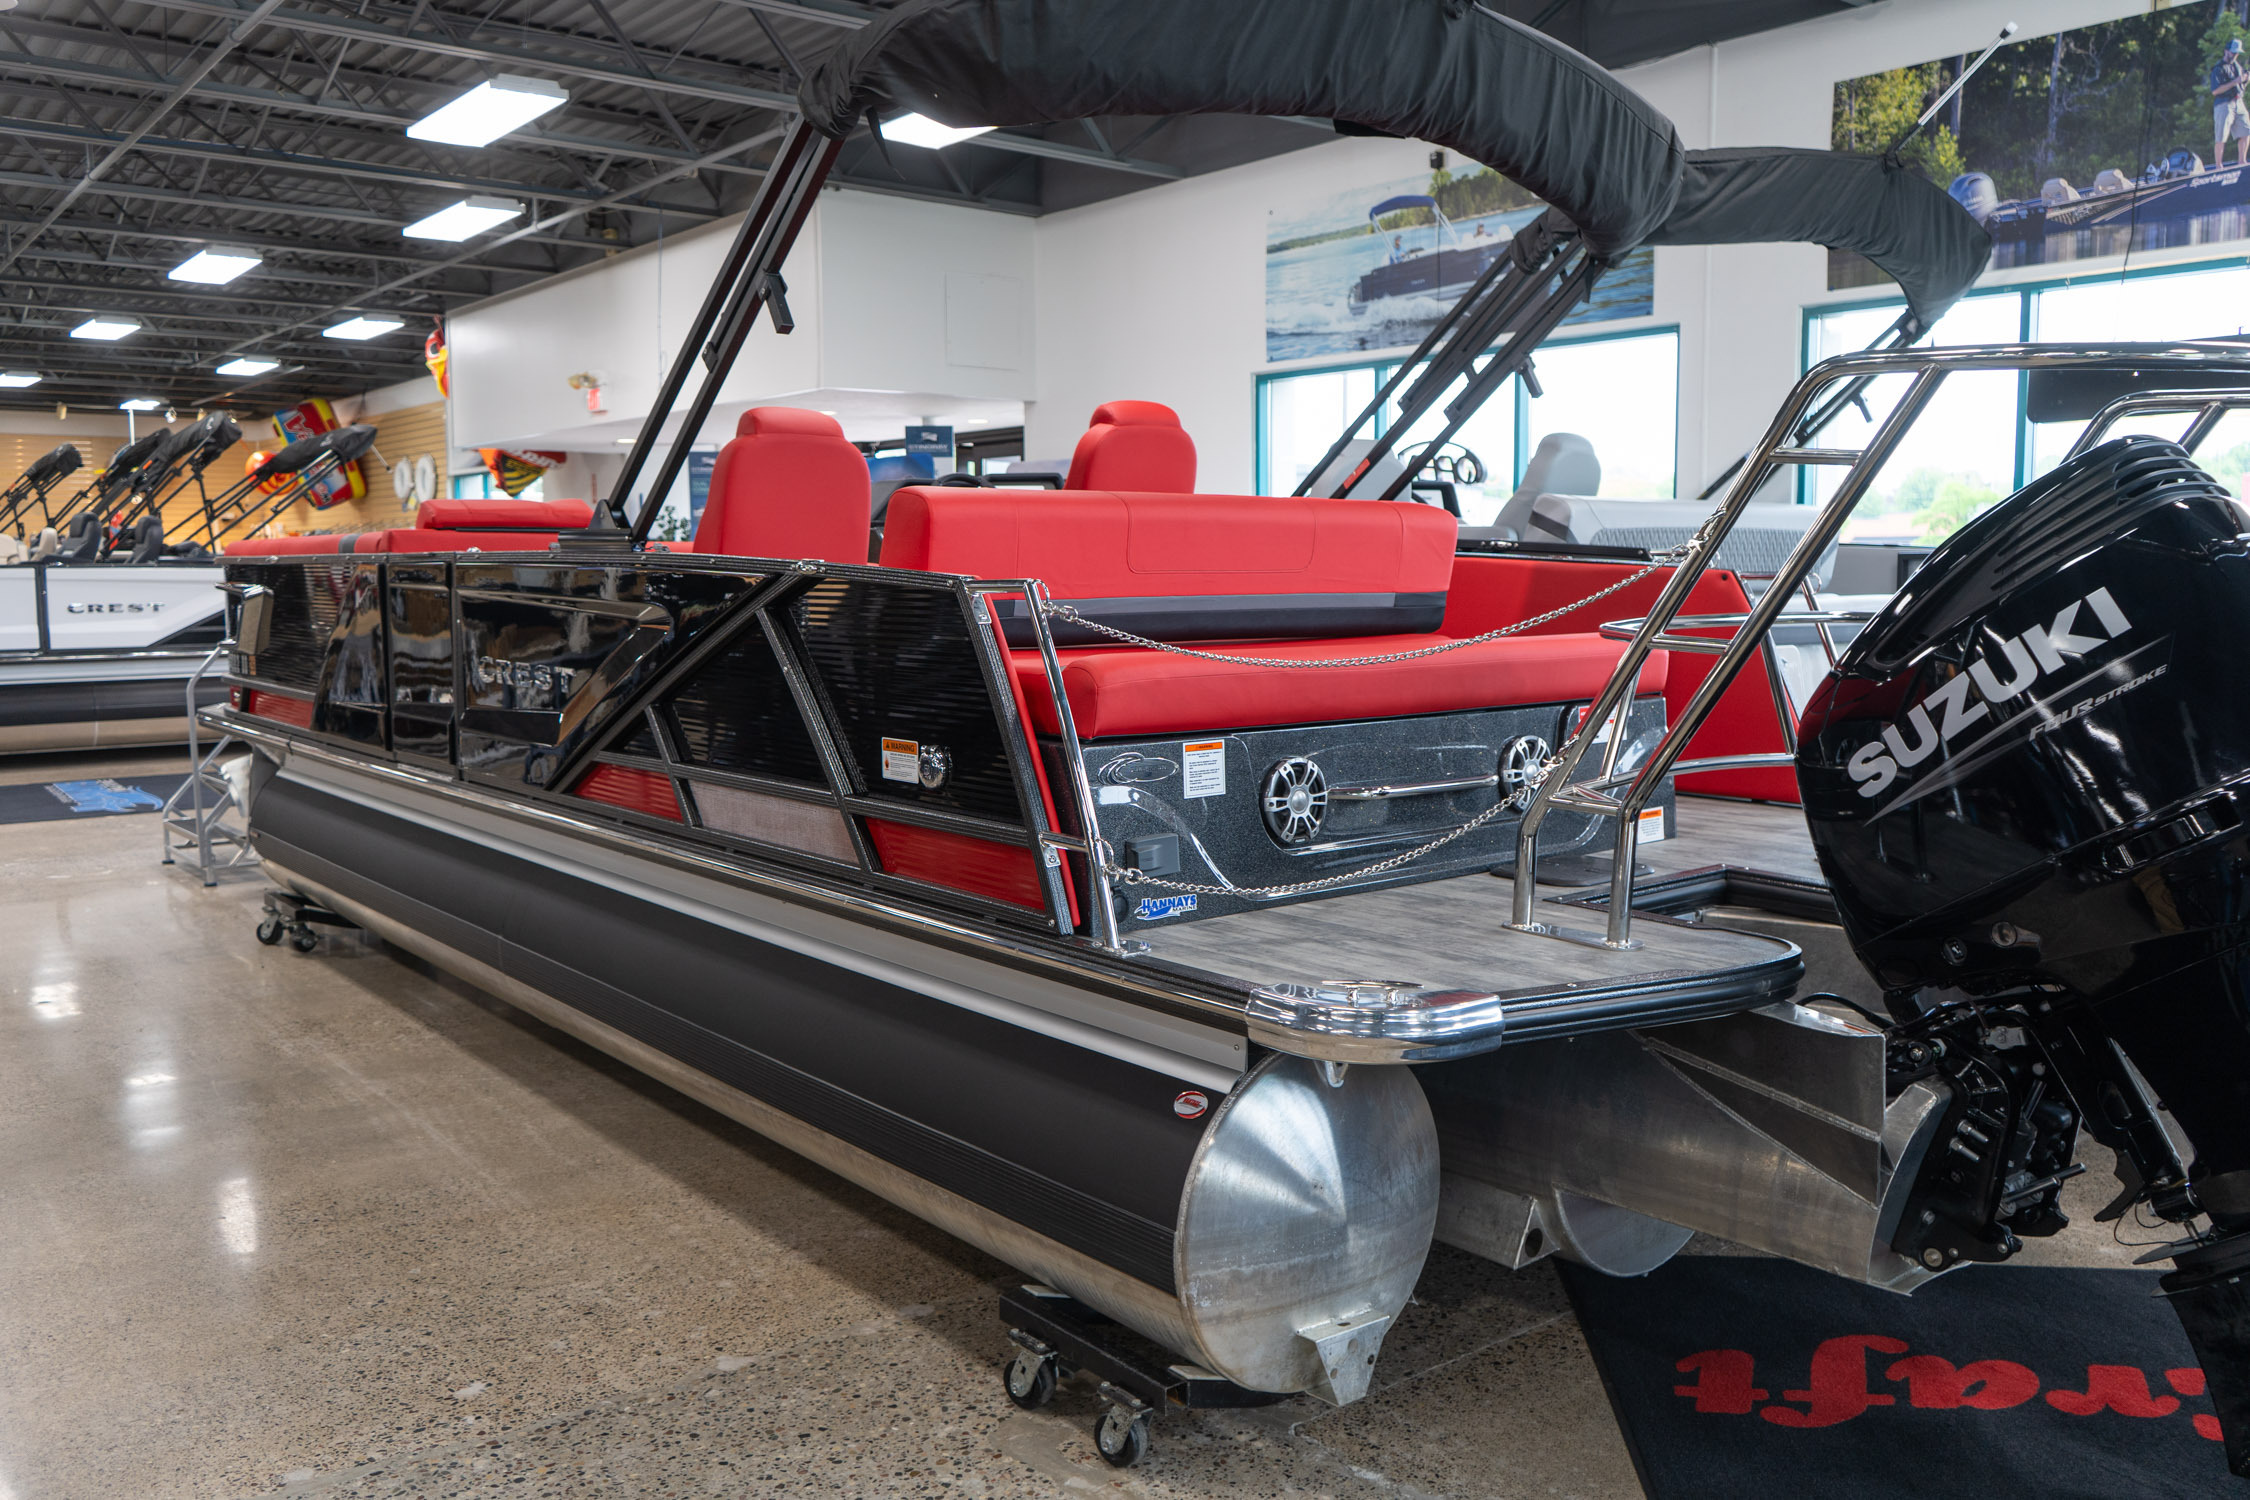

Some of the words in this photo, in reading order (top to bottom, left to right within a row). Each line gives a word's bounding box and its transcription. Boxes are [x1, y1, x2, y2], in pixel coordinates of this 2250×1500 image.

[67, 602, 166, 614] CREST
[478, 655, 576, 693] CREST
[1848, 586, 2132, 799] SUZUKI
[891, 742, 915, 752] WARNING
[1141, 894, 1197, 913] HANNAYS
[1172, 904, 1197, 912] MARINE
